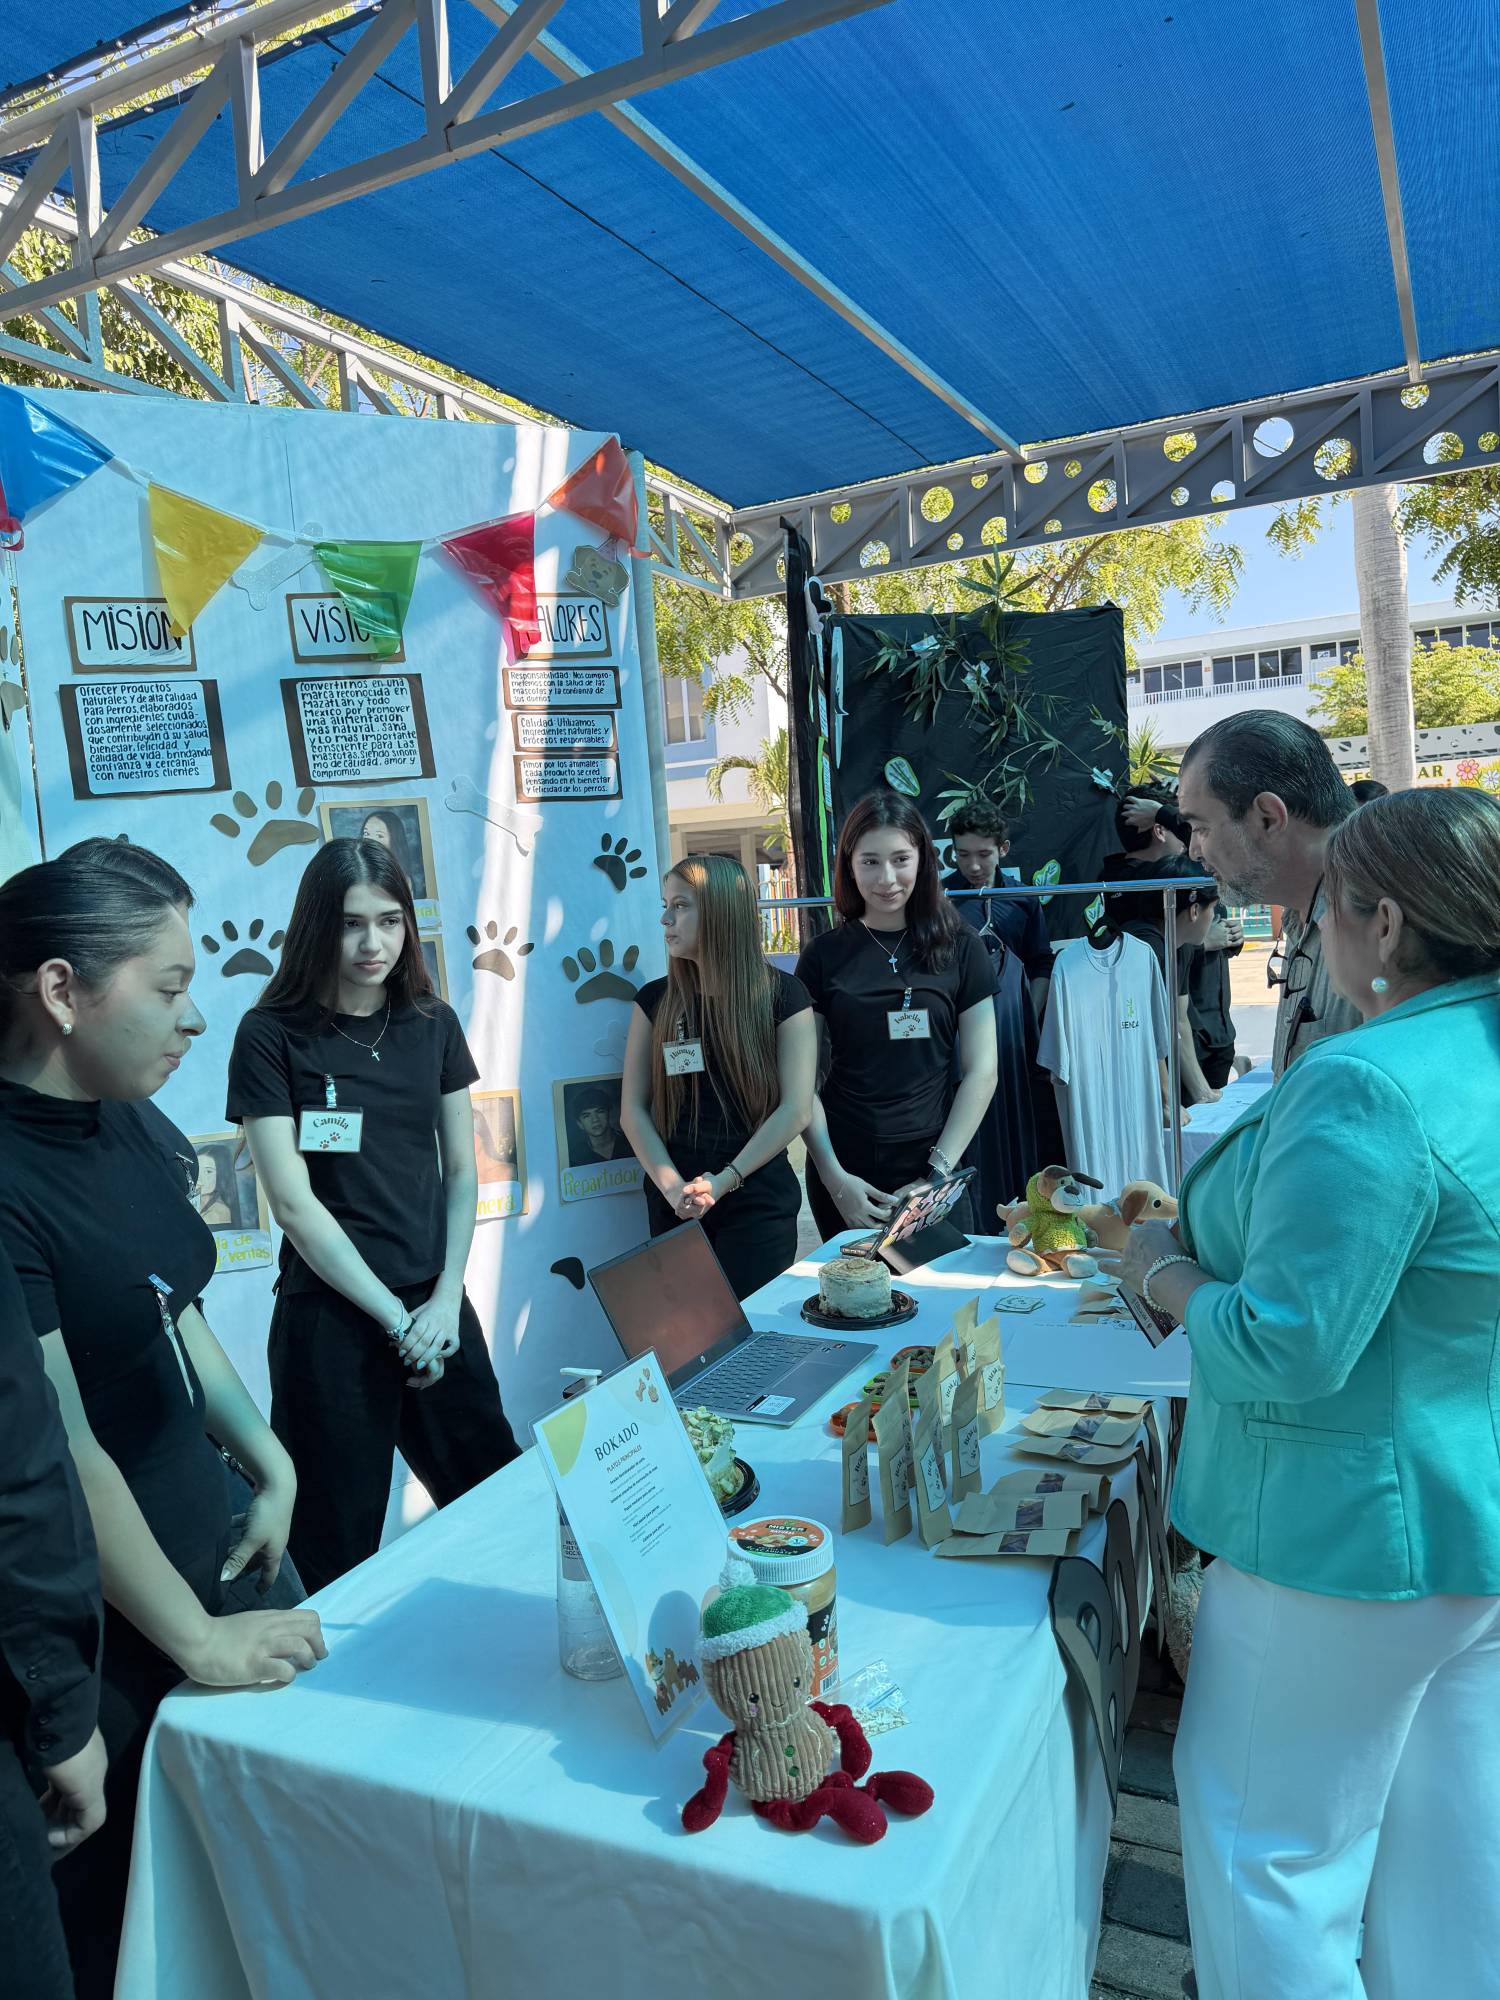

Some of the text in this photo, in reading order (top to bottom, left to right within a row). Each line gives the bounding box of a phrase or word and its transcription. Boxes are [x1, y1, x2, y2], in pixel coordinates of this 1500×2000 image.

[300, 602, 370, 643] VISI
[537, 604, 602, 642] ALORES
[371, 679, 383, 688] en
[386, 678, 404, 687] una
[557, 679, 564, 687] la
[566, 679, 583, 687] salud
[595, 679, 606, 687] las
[301, 687, 408, 701] marca reconocida en
[555, 687, 562, 695] la
[595, 687, 605, 695] de
[82, 694, 128, 706] naturales
[136, 693, 148, 703] de
[148, 693, 164, 703] alta
[366, 697, 390, 706] todo
[140, 701, 193, 713] elaborados
[345, 707, 362, 718] por
[366, 705, 410, 717] promover
[85, 717, 103, 726] con
[106, 711, 165, 726] ingredientes
[306, 717, 326, 726] una
[87, 723, 142, 735] dosamente
[381, 722, 407, 732] sana
[522, 726, 567, 737] ingredientes
[567, 724, 603, 736] naturales
[88, 736, 104, 745] que
[172, 731, 181, 740] su
[137, 740, 178, 751] felicidad
[311, 742, 368, 753] consciente
[371, 740, 393, 751] para
[90, 752, 124, 763] calidad
[127, 751, 138, 760] de
[166, 747, 212, 759] brindando
[91, 760, 141, 772] confianza
[313, 761, 329, 770] mo
[330, 760, 342, 768] de
[384, 757, 406, 766] amor
[409, 757, 416, 765] y
[544, 760, 556, 770] por
[557, 759, 568, 768] los
[95, 766, 200, 780] con nuestros clientes
[312, 768, 361, 779] compromiso
[577, 768, 585, 776] se
[560, 777, 568, 785] en
[578, 775, 611, 785] bienestar
[533, 784, 562, 794] felicidad
[564, 785, 571, 793] de
[894, 1012, 921, 1024] Isabella
[313, 1116, 349, 1130] Camila
[563, 1167, 641, 1198] Repartidor
[594, 1422, 639, 1462] BOKADO
